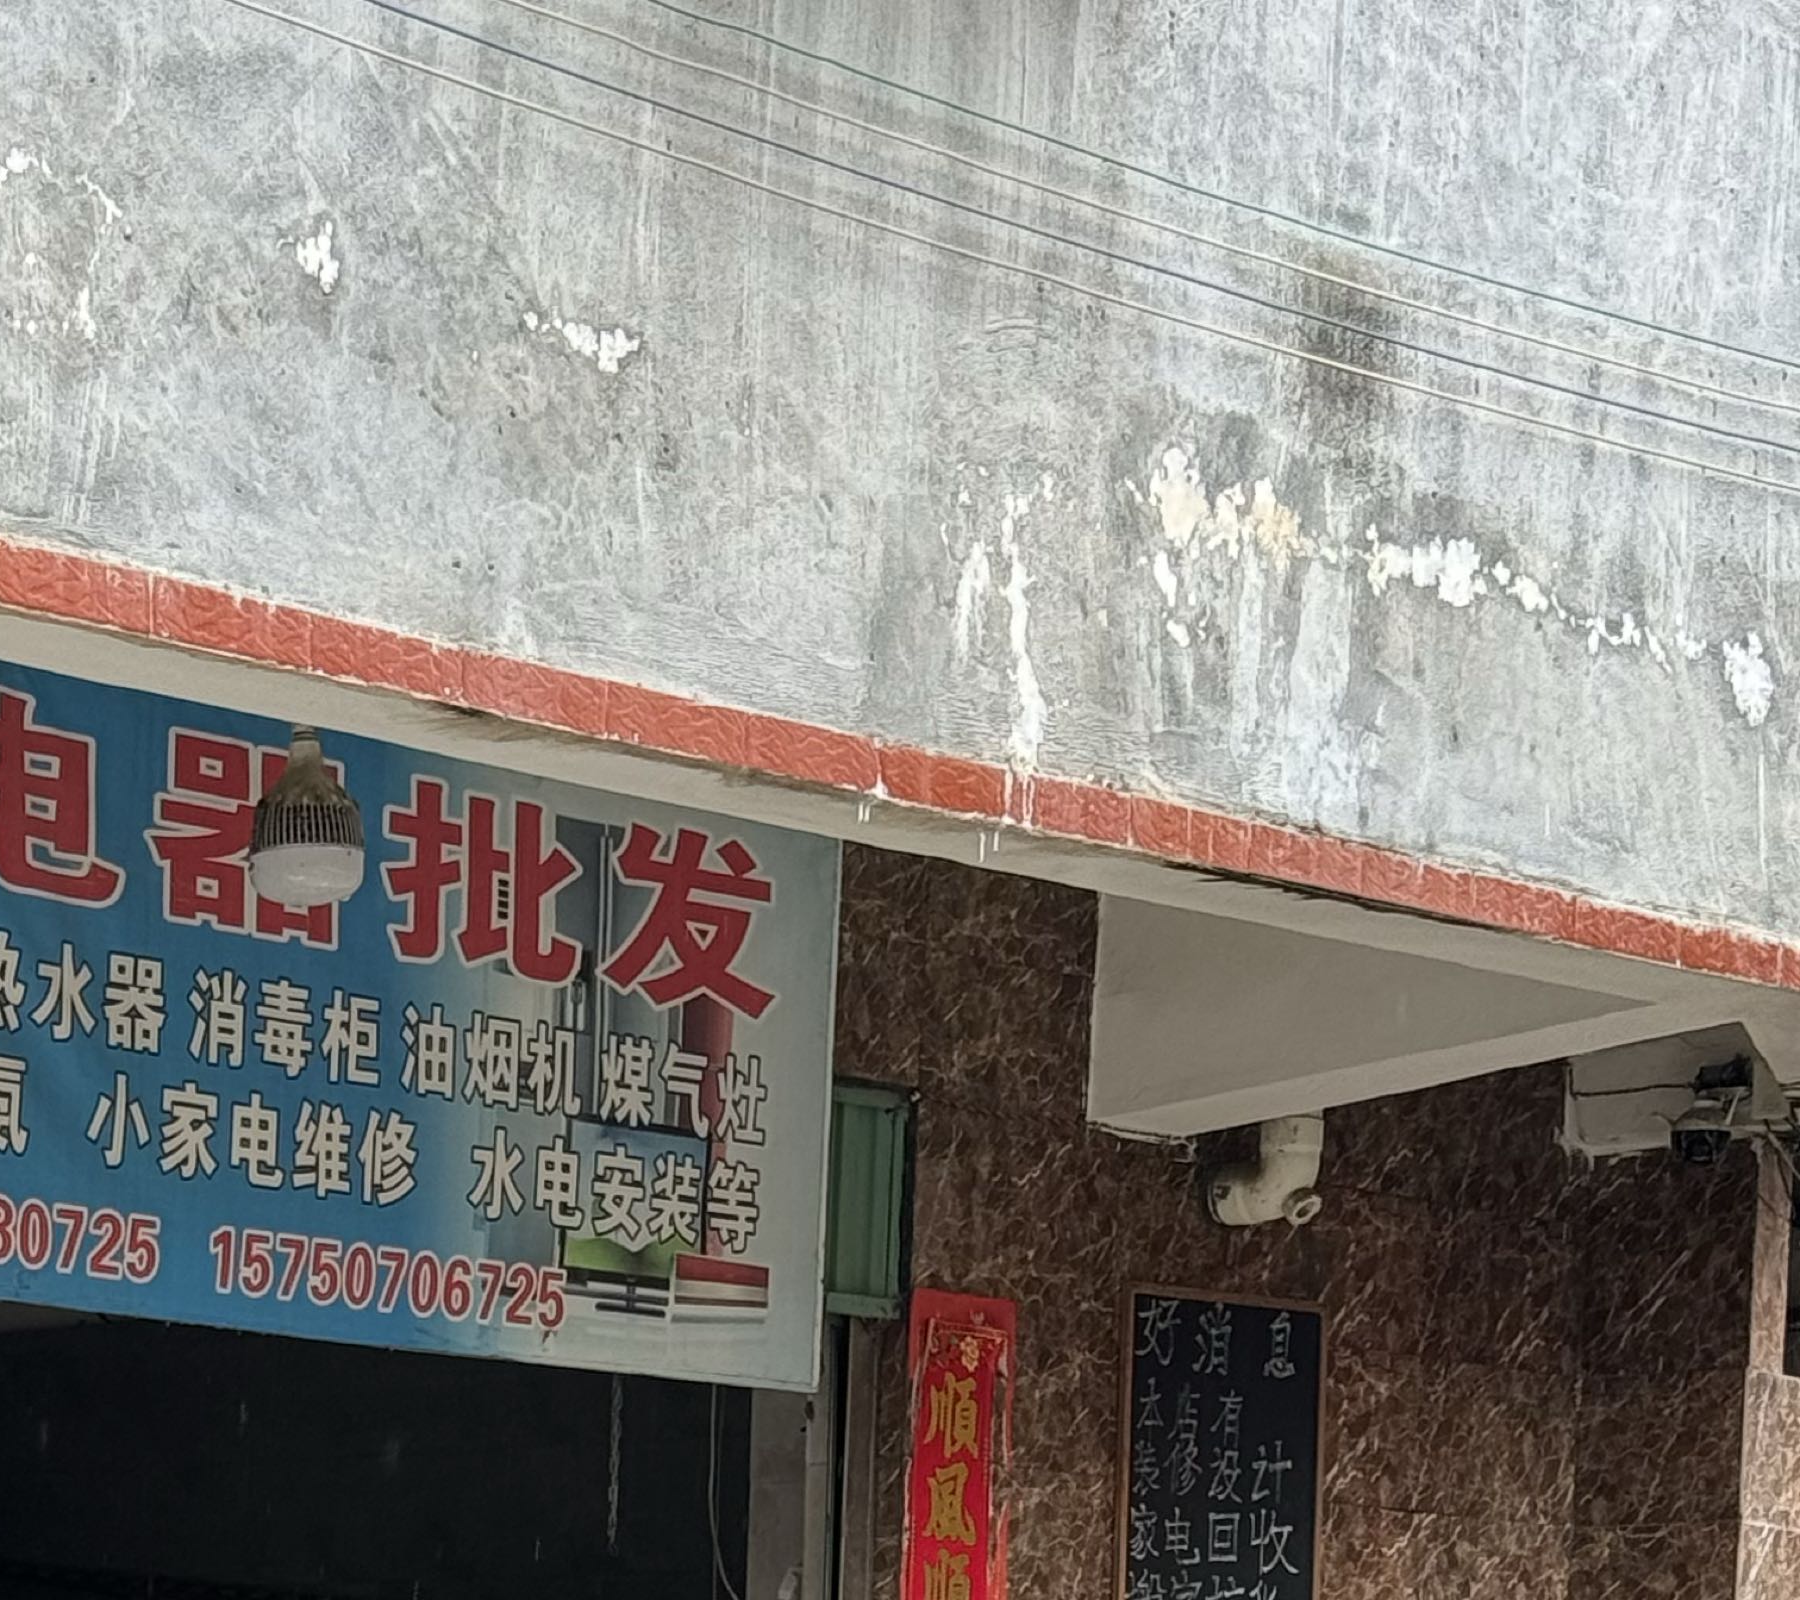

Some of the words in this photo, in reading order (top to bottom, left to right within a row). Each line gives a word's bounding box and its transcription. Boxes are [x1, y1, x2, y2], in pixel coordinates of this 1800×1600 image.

[188, 969, 382, 1091] 消毒柜
[402, 1003, 582, 1118] 油烟机
[600, 1033, 768, 1149] 煤气灶
[86, 1073, 419, 1209] 小家电维修
[469, 1128, 762, 1253] 水电安装等
[210, 1224, 567, 1331] 15750706725
[1137, 1299, 1296, 1378] 好消息
[1137, 1377, 1244, 1449] 本店有
[1132, 1440, 1293, 1503] 装修设计
[1130, 1503, 1300, 1575] 家电回收
